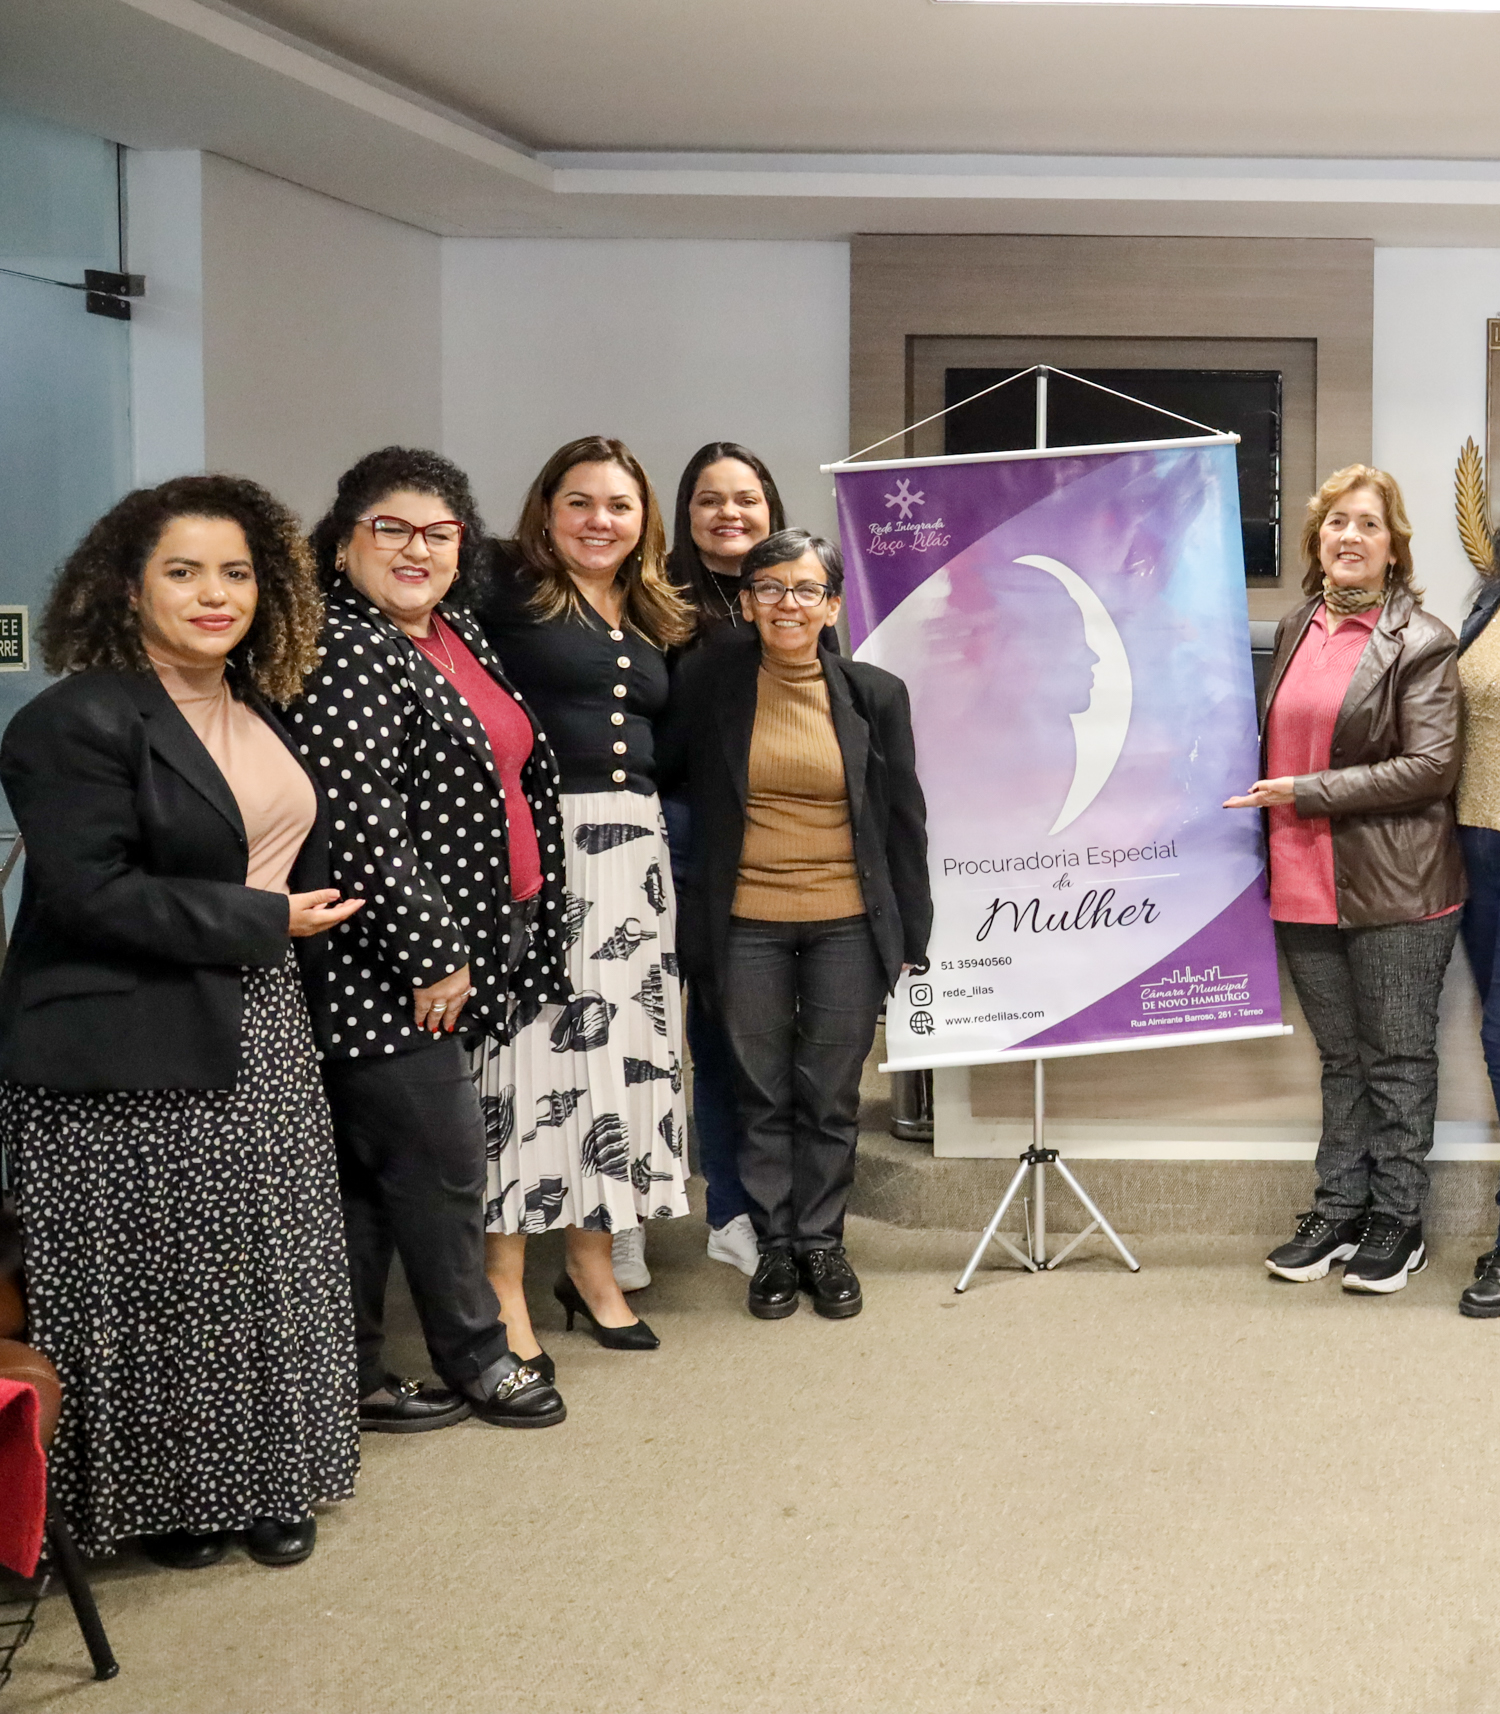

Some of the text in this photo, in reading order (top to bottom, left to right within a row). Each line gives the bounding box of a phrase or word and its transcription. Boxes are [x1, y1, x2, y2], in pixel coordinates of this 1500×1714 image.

[868, 518, 945, 535] Rede Integrada
[866, 531, 951, 556] Laço Lilás
[943, 840, 1178, 876] Procuradoria Especial
[1053, 872, 1074, 890] da
[976, 888, 1160, 942] Mulher
[941, 956, 1012, 971] 51 35940560
[942, 986, 994, 998] rede_lilas
[1140, 978, 1248, 1000] Câmara Municipal
[1142, 991, 1250, 1010] DE NOVO HAMBURGO
[945, 1010, 1045, 1026] www.redelilas.com
[1131, 1020, 1147, 1028] Rua
[1147, 1016, 1183, 1026] Almirante
[1184, 1014, 1216, 1023] Barroso,
[1238, 1008, 1264, 1017] Térreo
